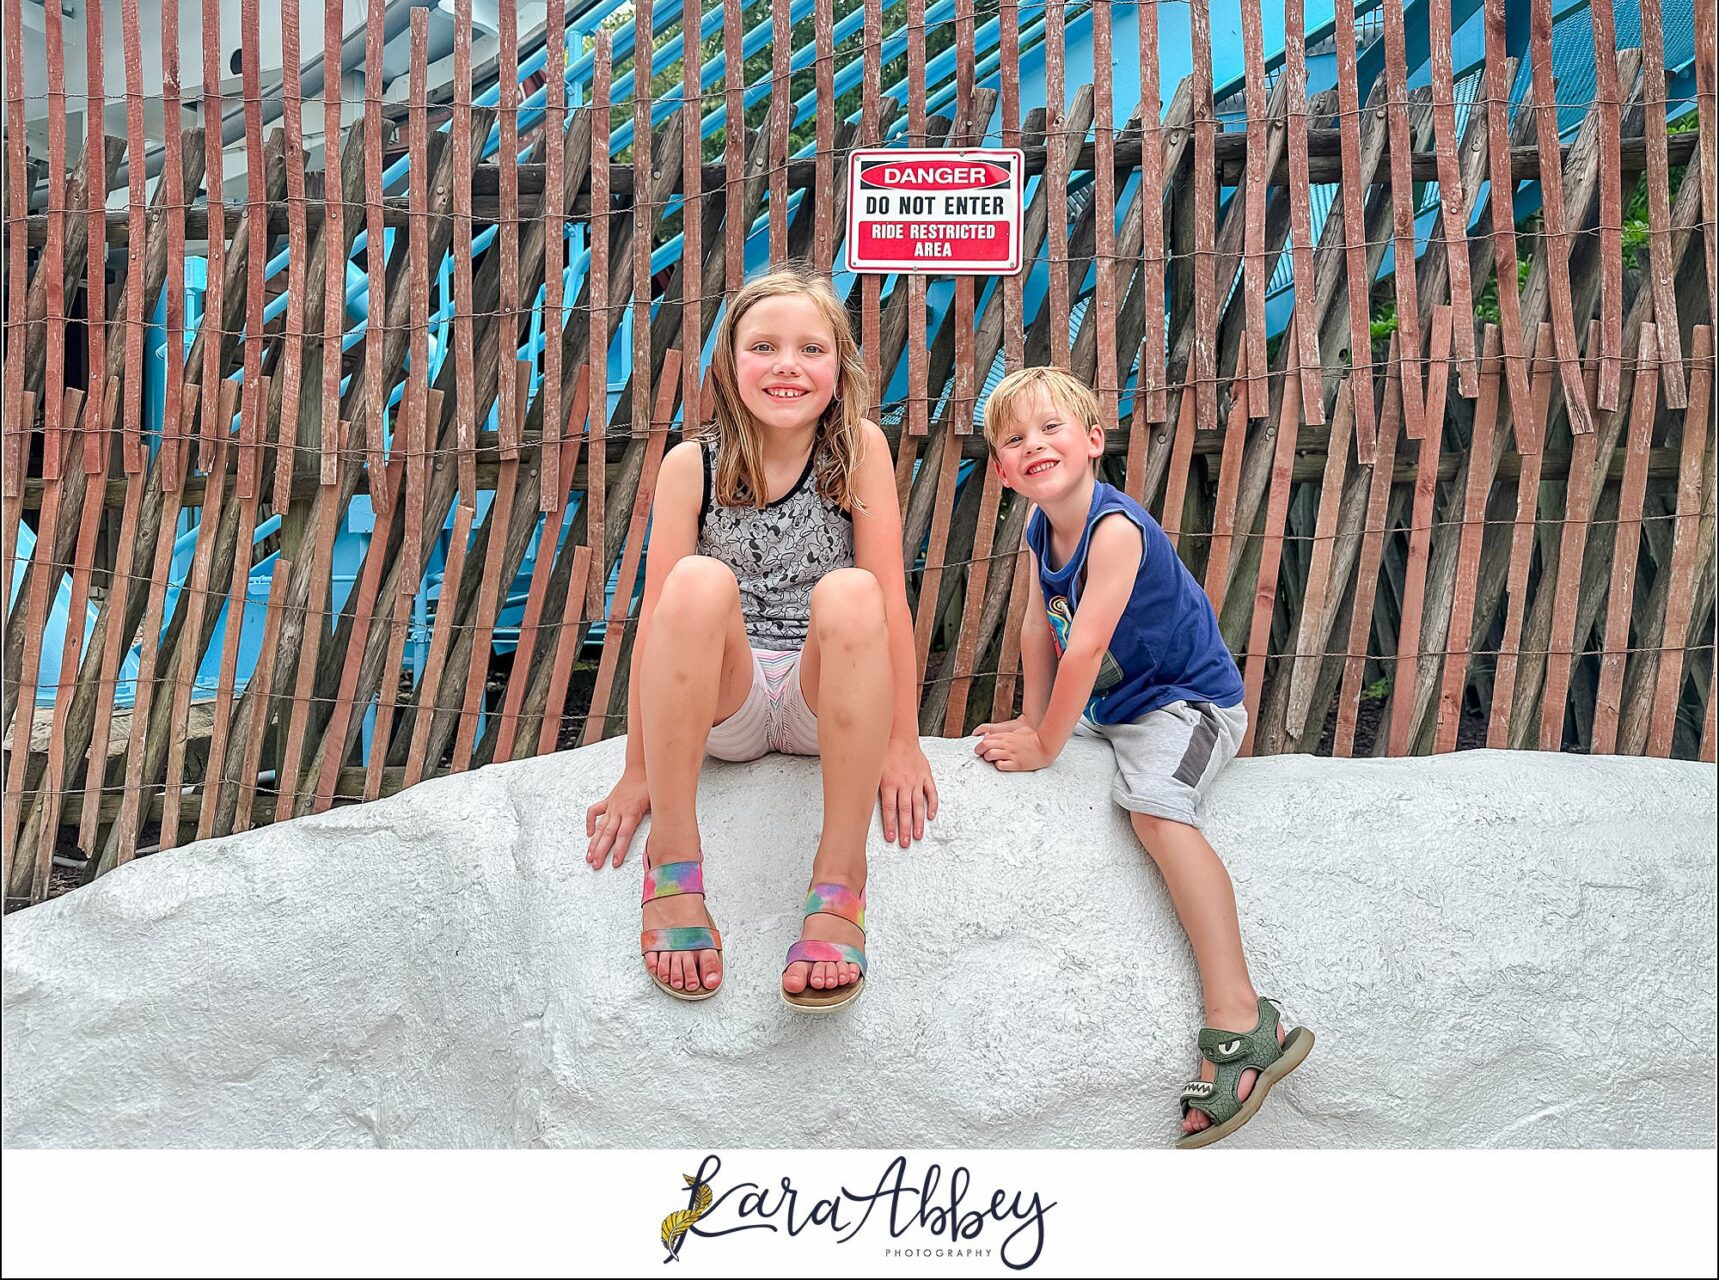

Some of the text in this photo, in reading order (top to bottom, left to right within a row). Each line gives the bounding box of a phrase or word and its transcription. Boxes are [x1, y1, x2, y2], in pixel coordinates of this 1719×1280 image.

[884, 168, 986, 184] DANGER
[866, 196, 1004, 215] DO NOT ENTER
[871, 224, 996, 239] RIDE RESTRICTED
[914, 242, 952, 257] AREA
